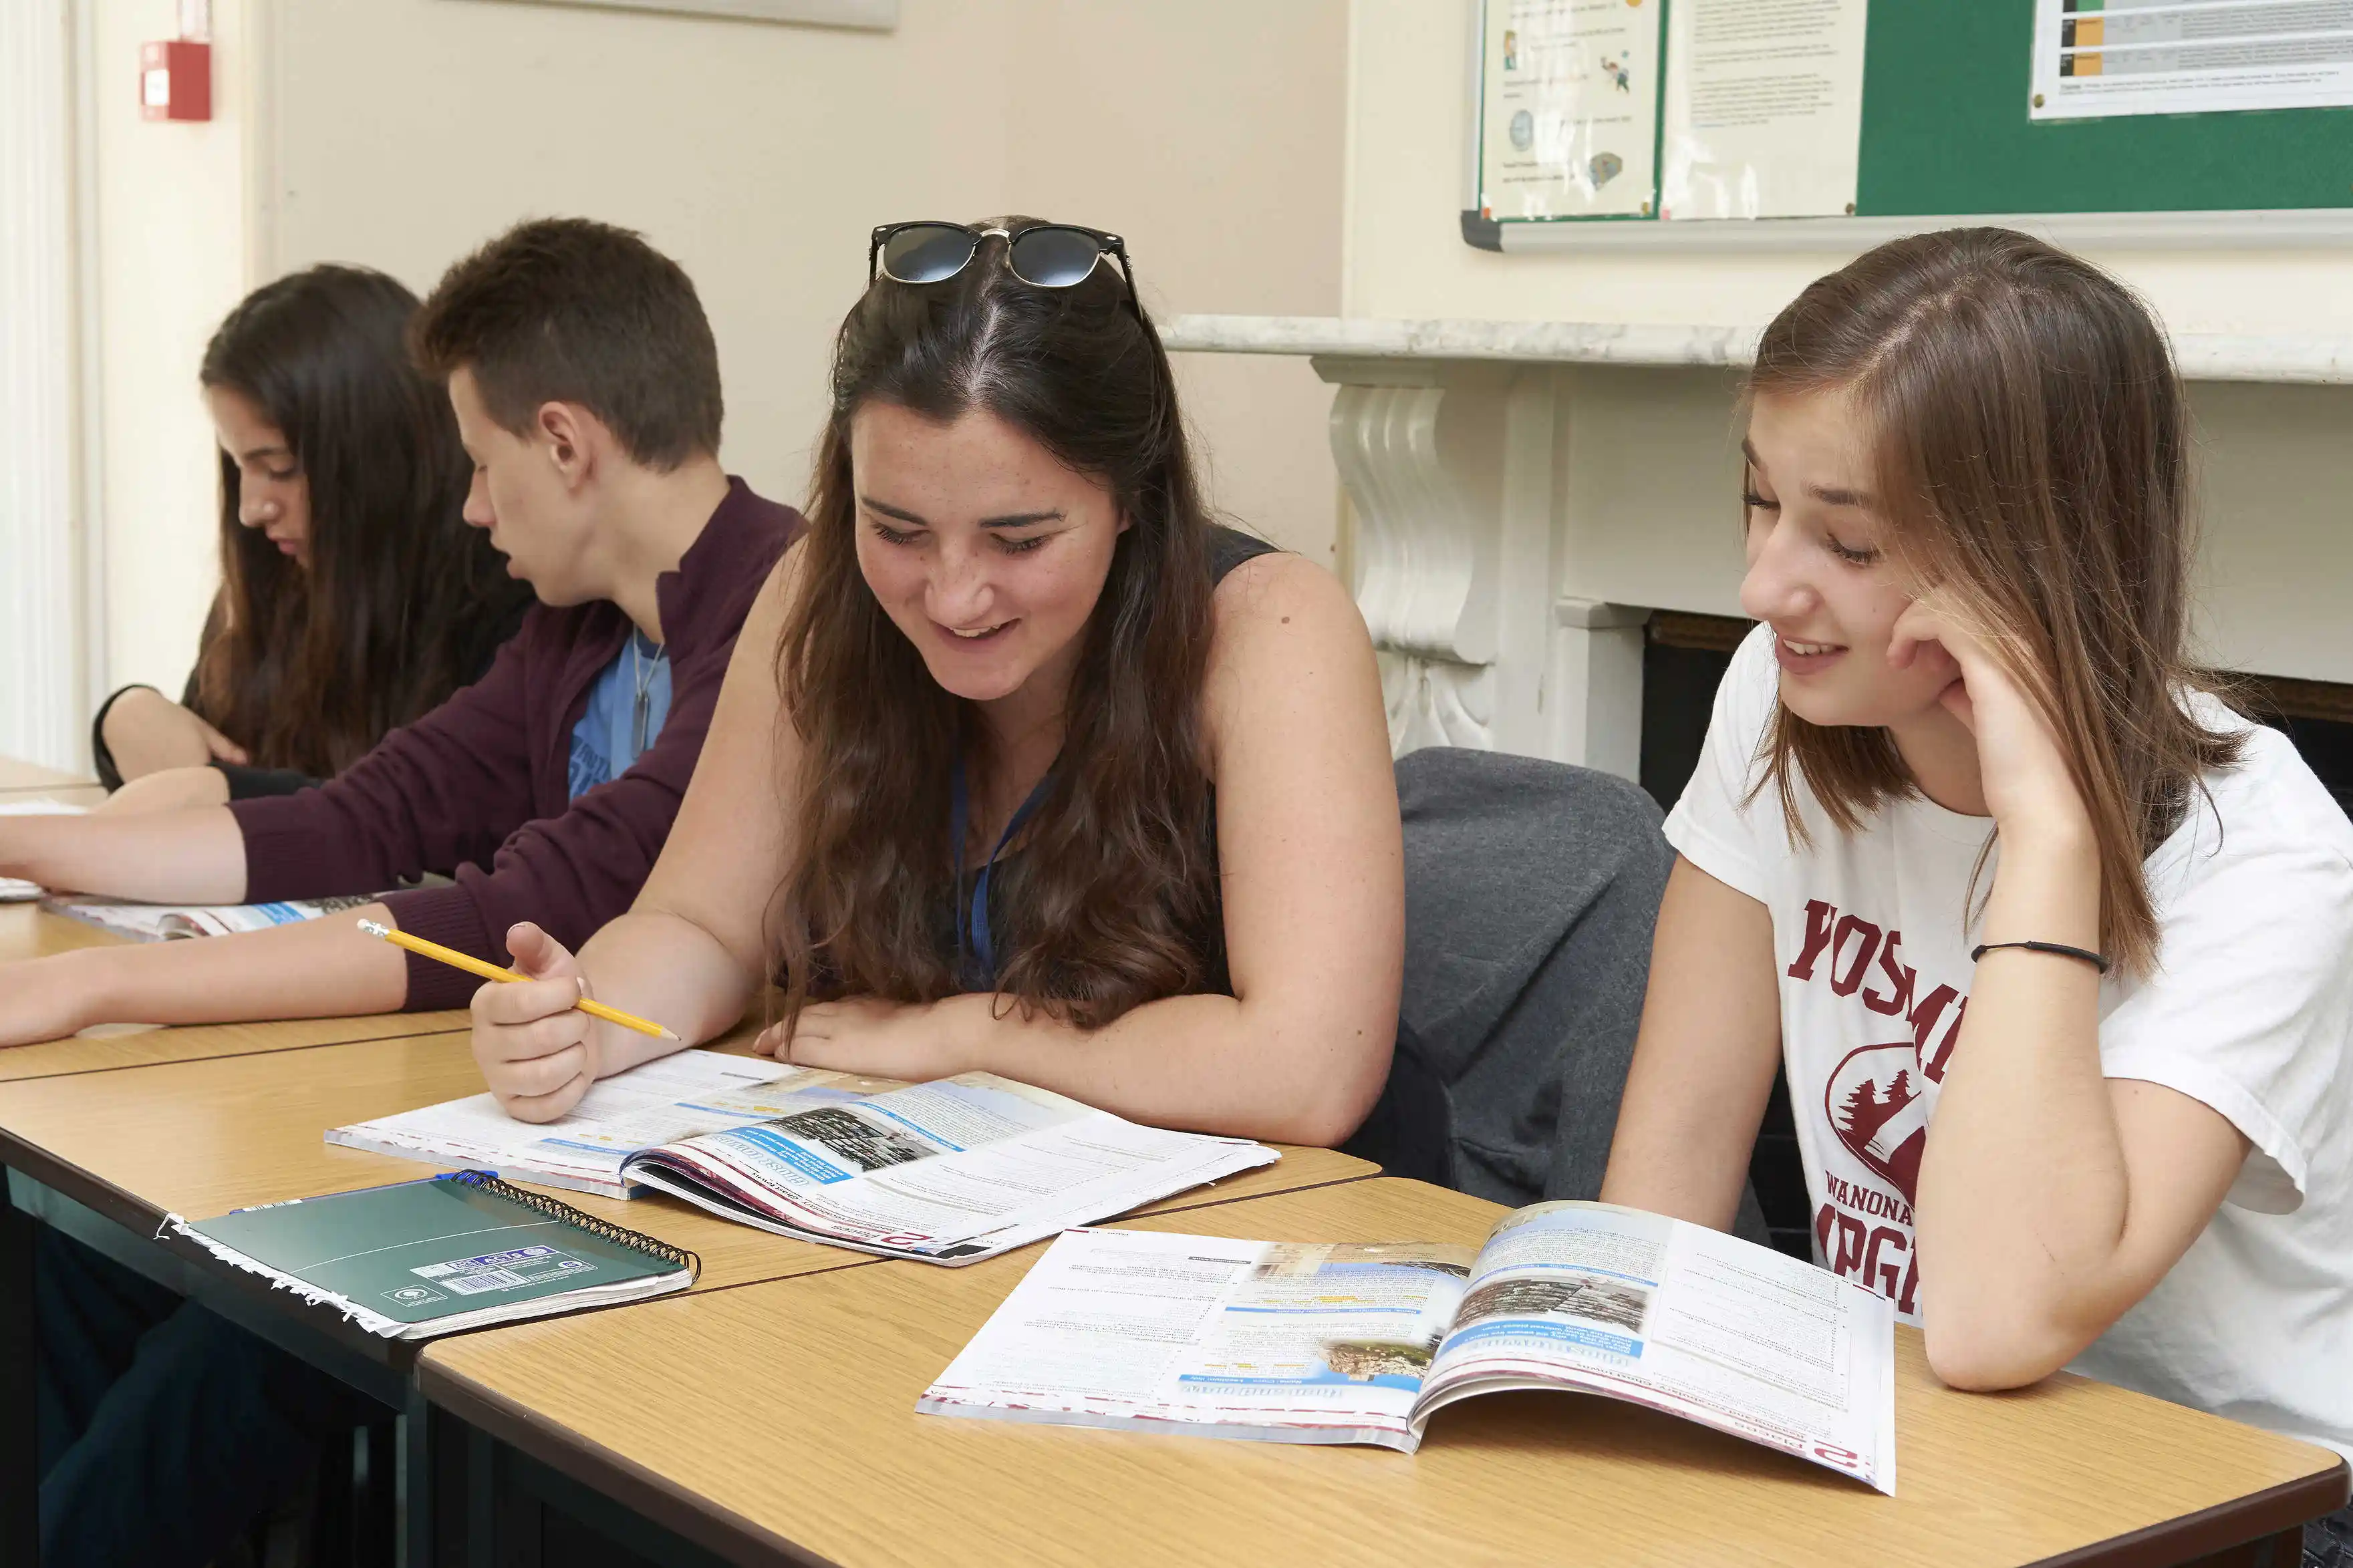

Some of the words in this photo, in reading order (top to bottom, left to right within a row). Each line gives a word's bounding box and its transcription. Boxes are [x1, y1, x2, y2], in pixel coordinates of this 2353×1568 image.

[751, 1172, 776, 1189] towns
[775, 1186, 799, 1201] Ghost
[1825, 1170, 1913, 1227] WANONA
[800, 1200, 847, 1222] vocabulary
[830, 1224, 881, 1239] Places
